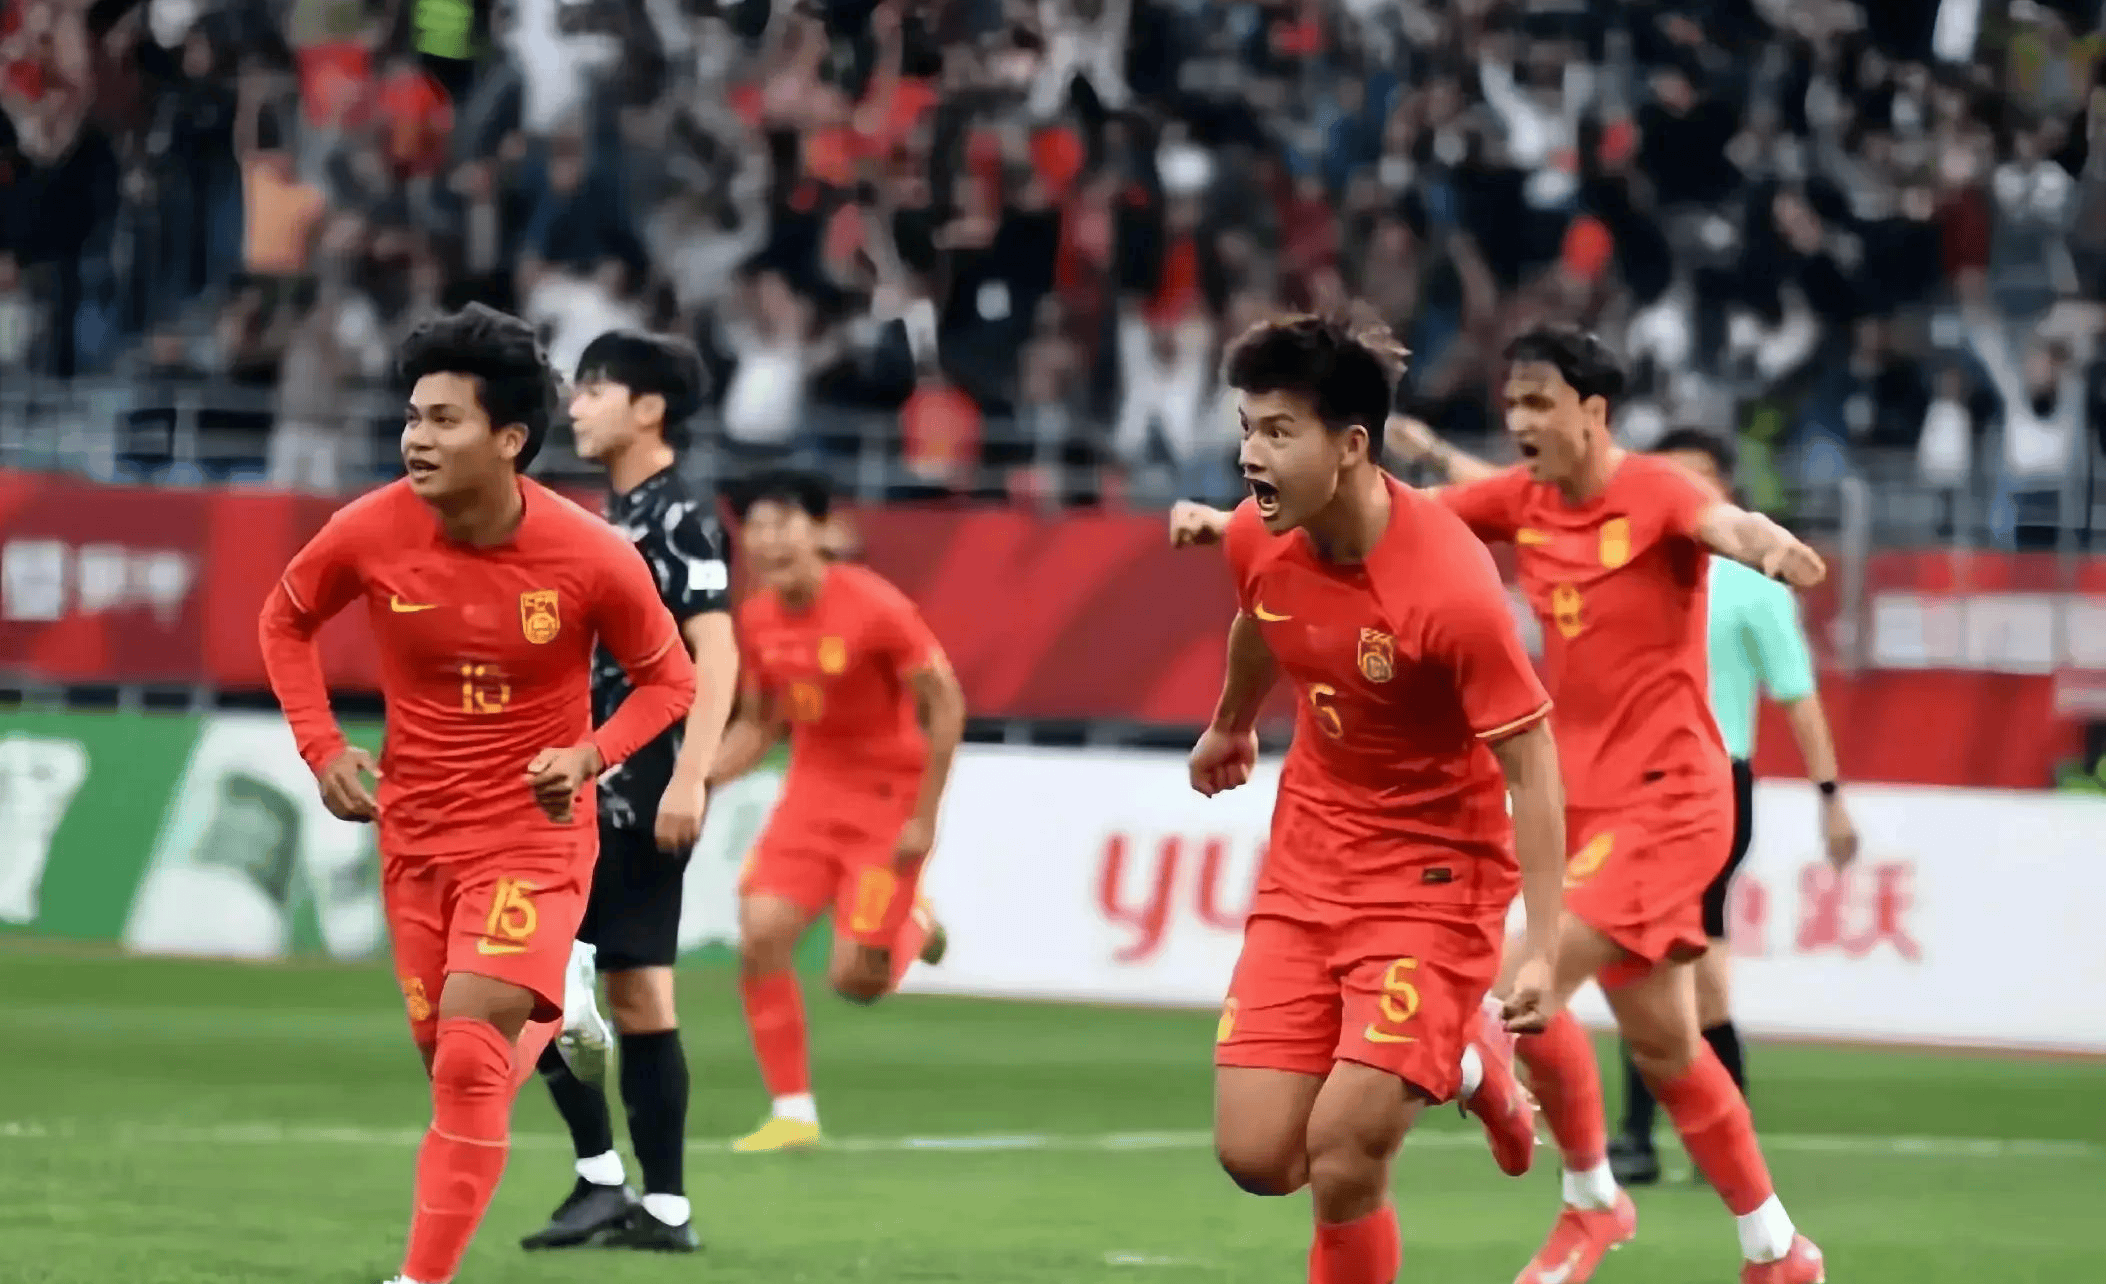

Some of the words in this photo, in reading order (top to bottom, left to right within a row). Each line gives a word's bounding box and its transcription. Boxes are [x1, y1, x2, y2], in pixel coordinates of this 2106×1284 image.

[1310, 683, 1343, 739] 5
[486, 877, 538, 938] 15
[1381, 958, 1419, 1023] 5
